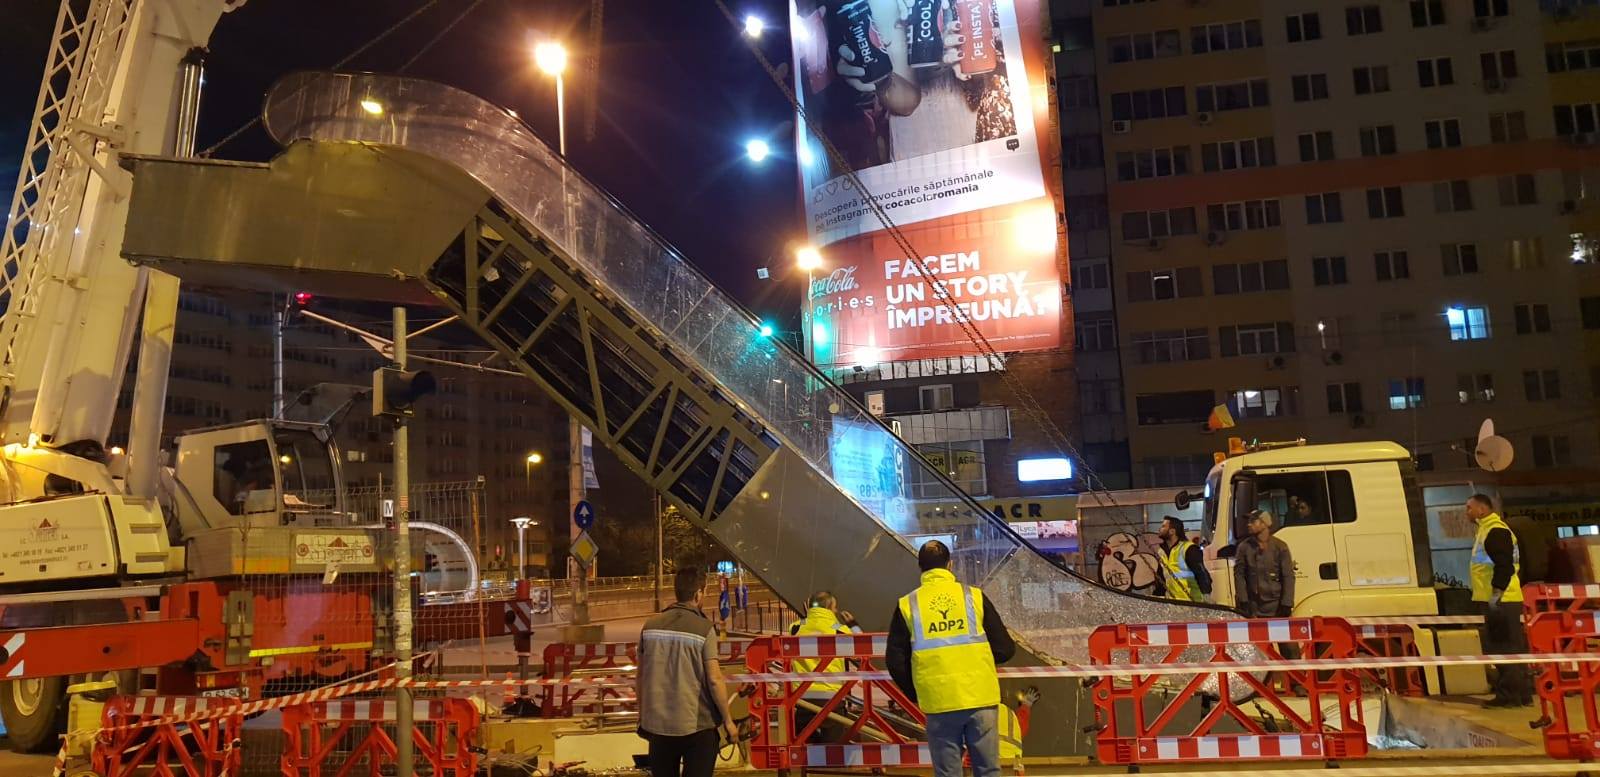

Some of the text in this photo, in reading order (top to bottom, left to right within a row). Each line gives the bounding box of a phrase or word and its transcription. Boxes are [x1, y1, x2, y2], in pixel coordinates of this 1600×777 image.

[973, 43, 984, 56] PE
[923, 169, 994, 191] săptămânale
[884, 251, 980, 279] FACEM
[886, 271, 1029, 304] UN STORY
[993, 503, 1042, 519] ACR
[928, 619, 965, 633] ADP2
